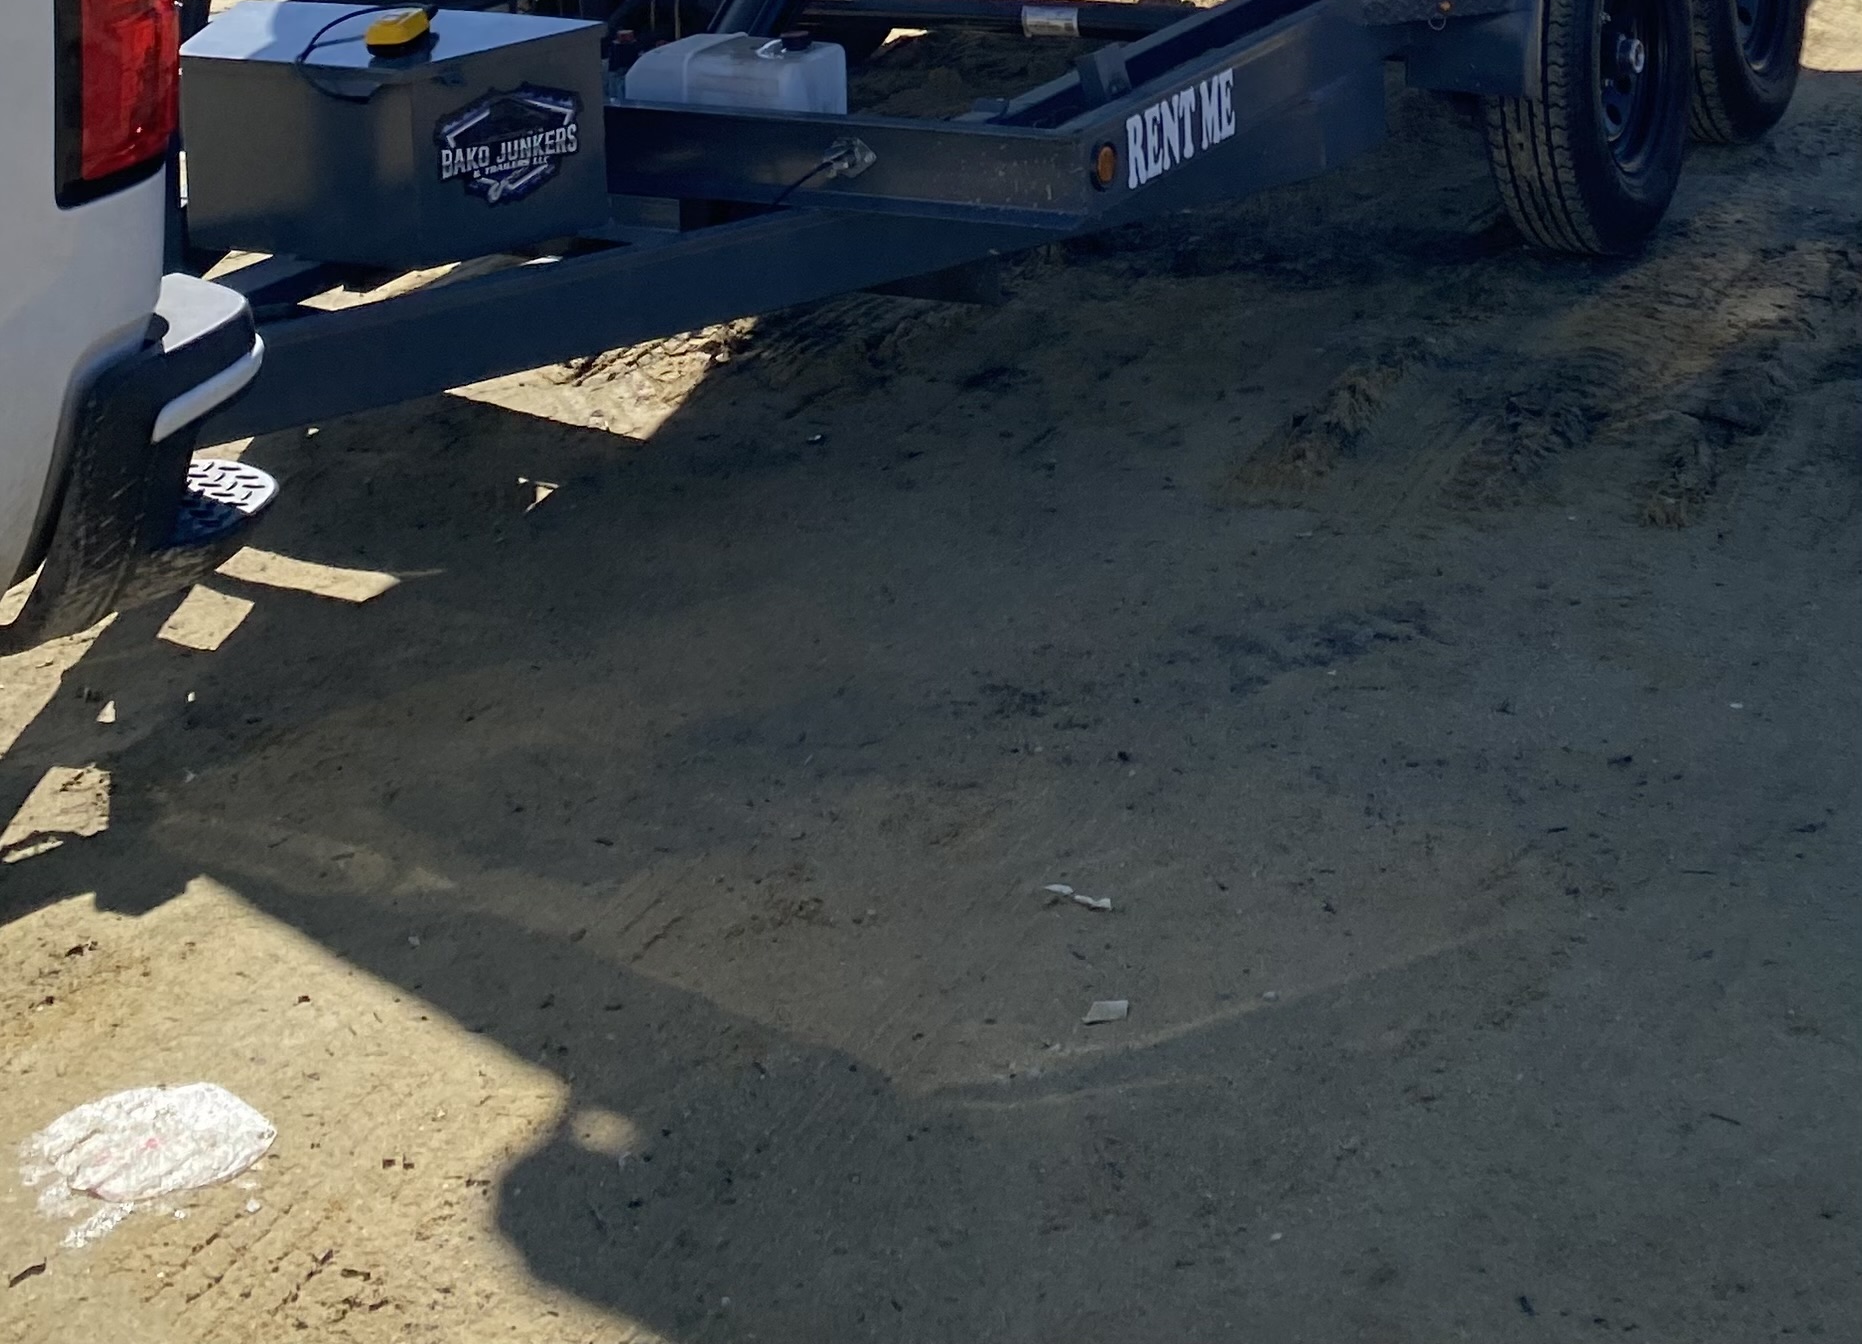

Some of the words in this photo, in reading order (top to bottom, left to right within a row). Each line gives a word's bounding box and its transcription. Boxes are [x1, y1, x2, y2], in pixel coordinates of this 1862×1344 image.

[441, 145, 490, 179] BAKO
[496, 124, 577, 162] JUNKERS
[1126, 86, 1196, 190] RENT
[1200, 69, 1235, 150] ME
